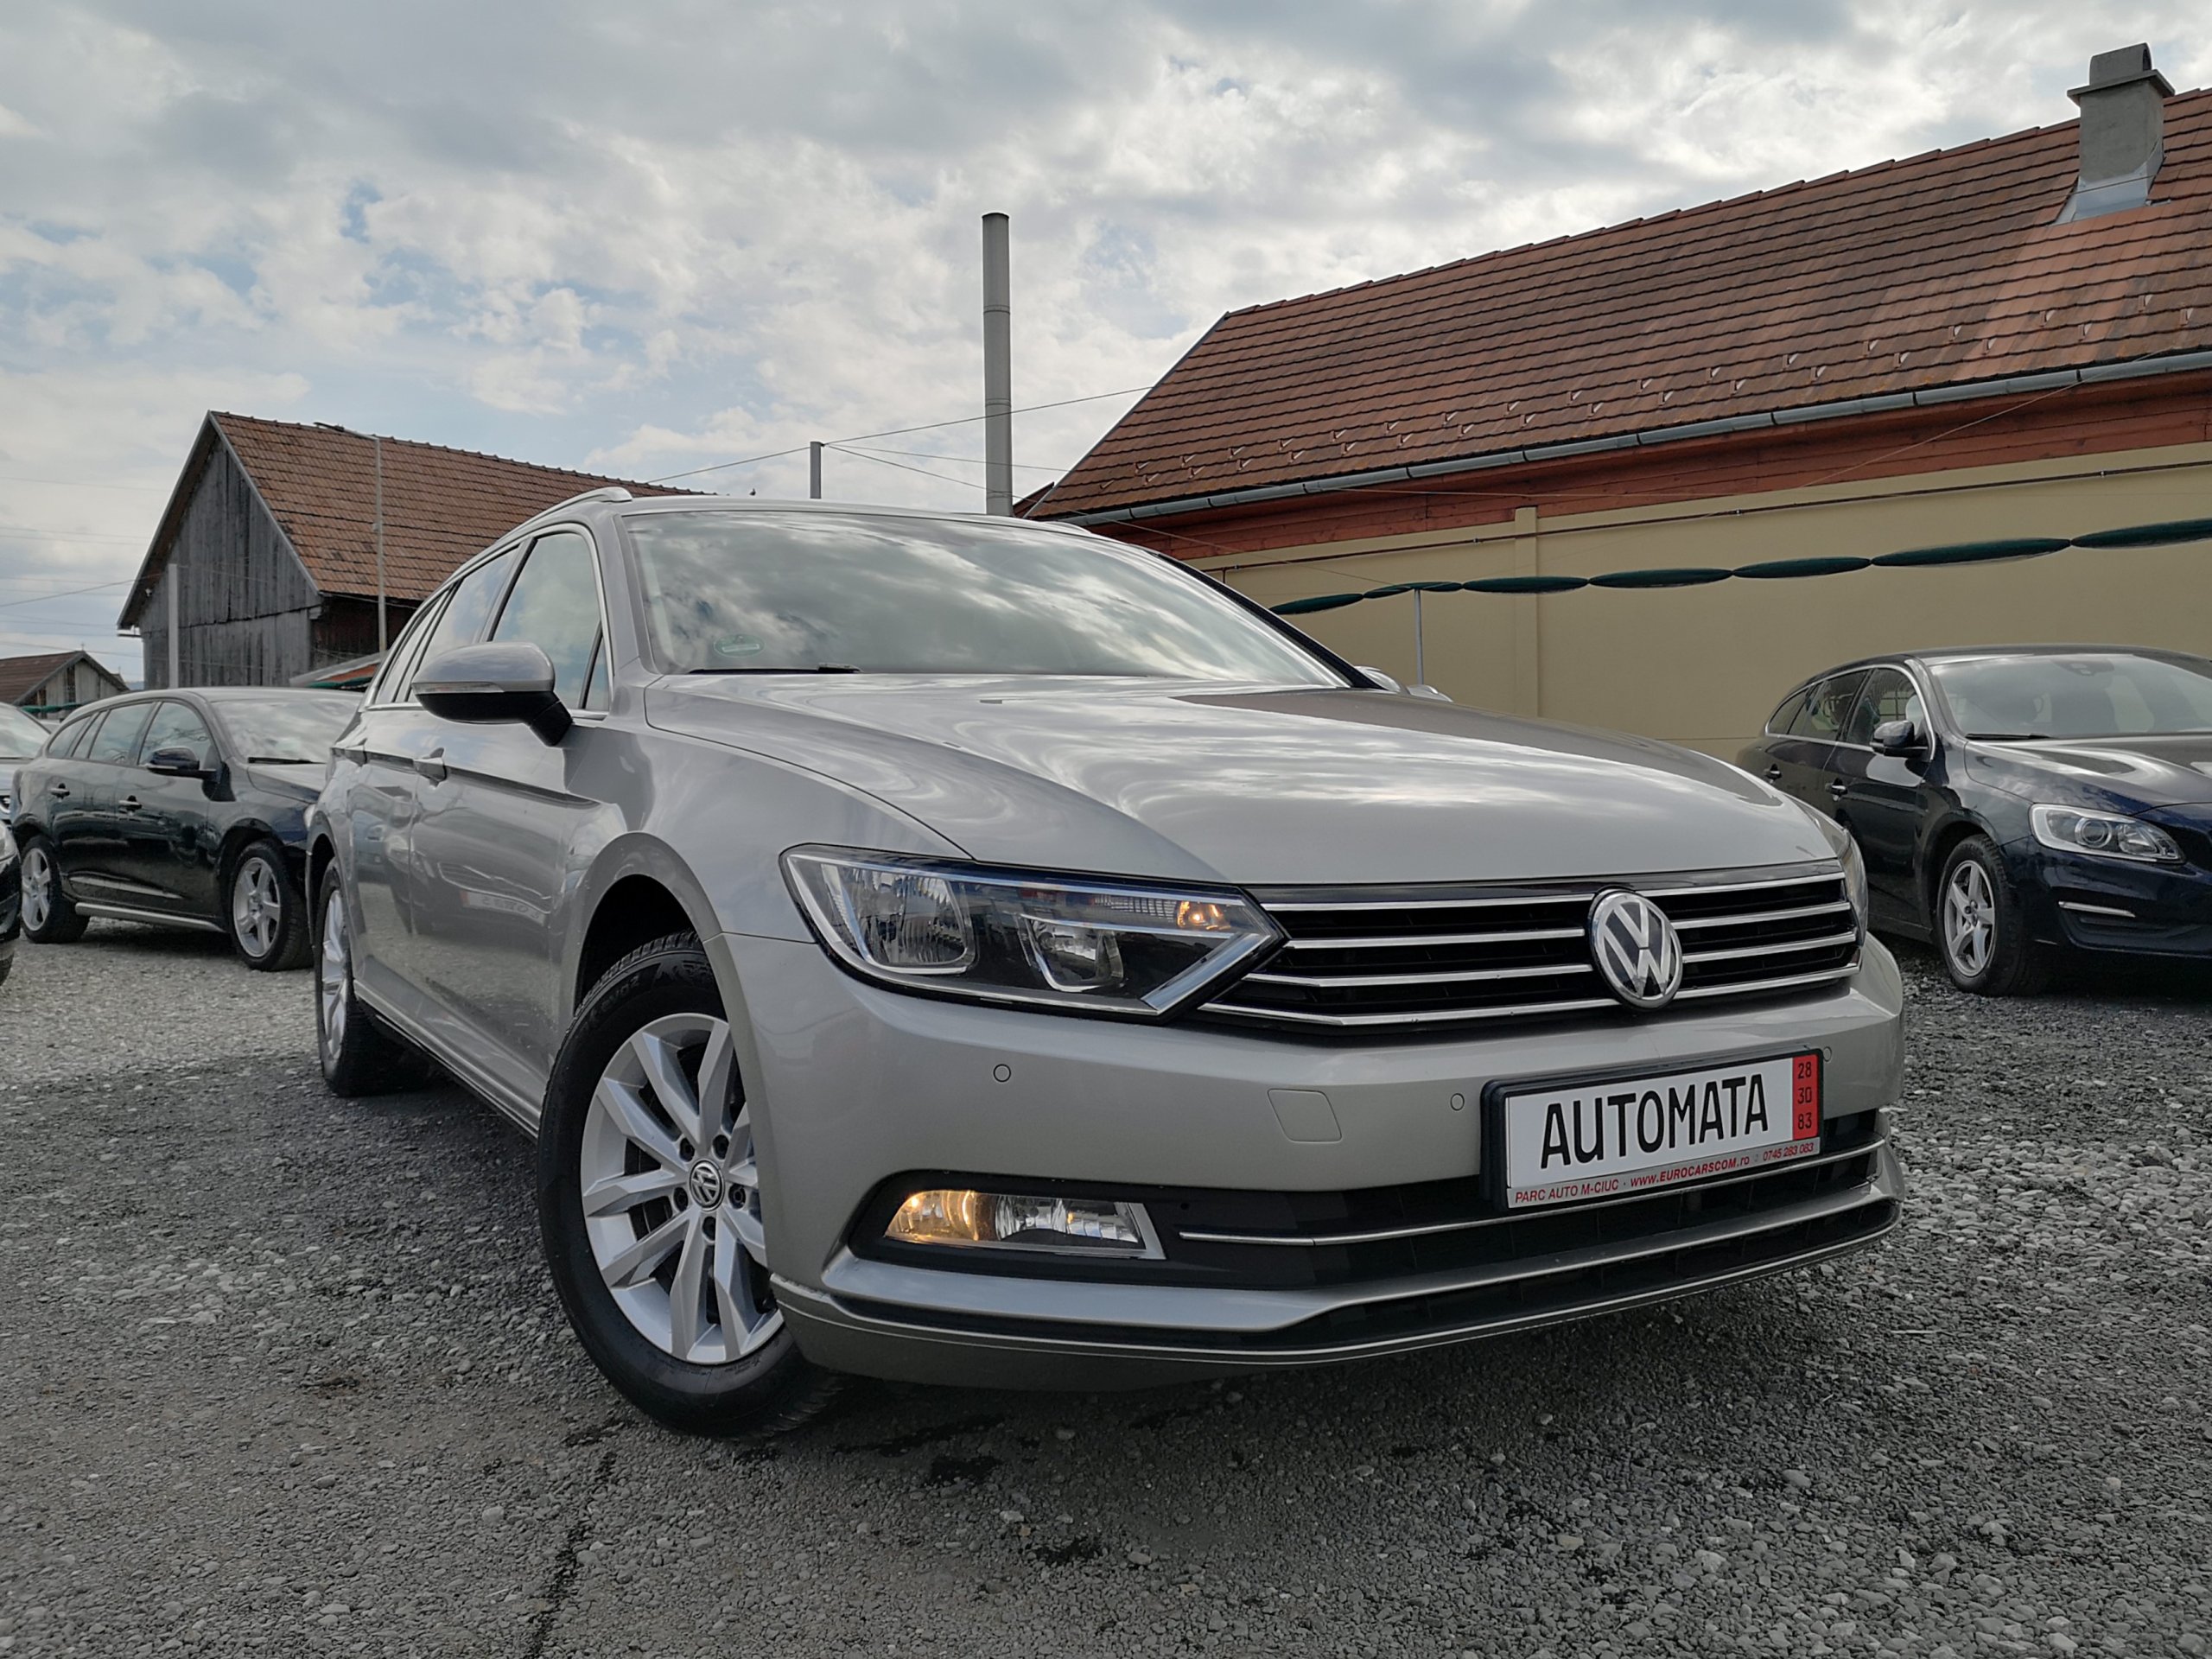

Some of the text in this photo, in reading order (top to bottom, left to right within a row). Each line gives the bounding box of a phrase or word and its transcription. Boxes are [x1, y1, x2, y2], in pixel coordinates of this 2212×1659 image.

[1599, 898, 1676, 1002] VW
[1796, 1061, 1813, 1079] 28
[1796, 1087, 1813, 1104] 30
[1540, 1073, 1769, 1169] AUTOMATA
[1796, 1112, 1813, 1130] 83
[1515, 1188, 1546, 1204] PARC
[1548, 1185, 1579, 1200] AUTO
[1581, 1179, 1619, 1196] M-CIUC
[1763, 1147, 1782, 1161] 0745
[1783, 1145, 1798, 1158] 283
[1800, 1142, 1814, 1154] 083
